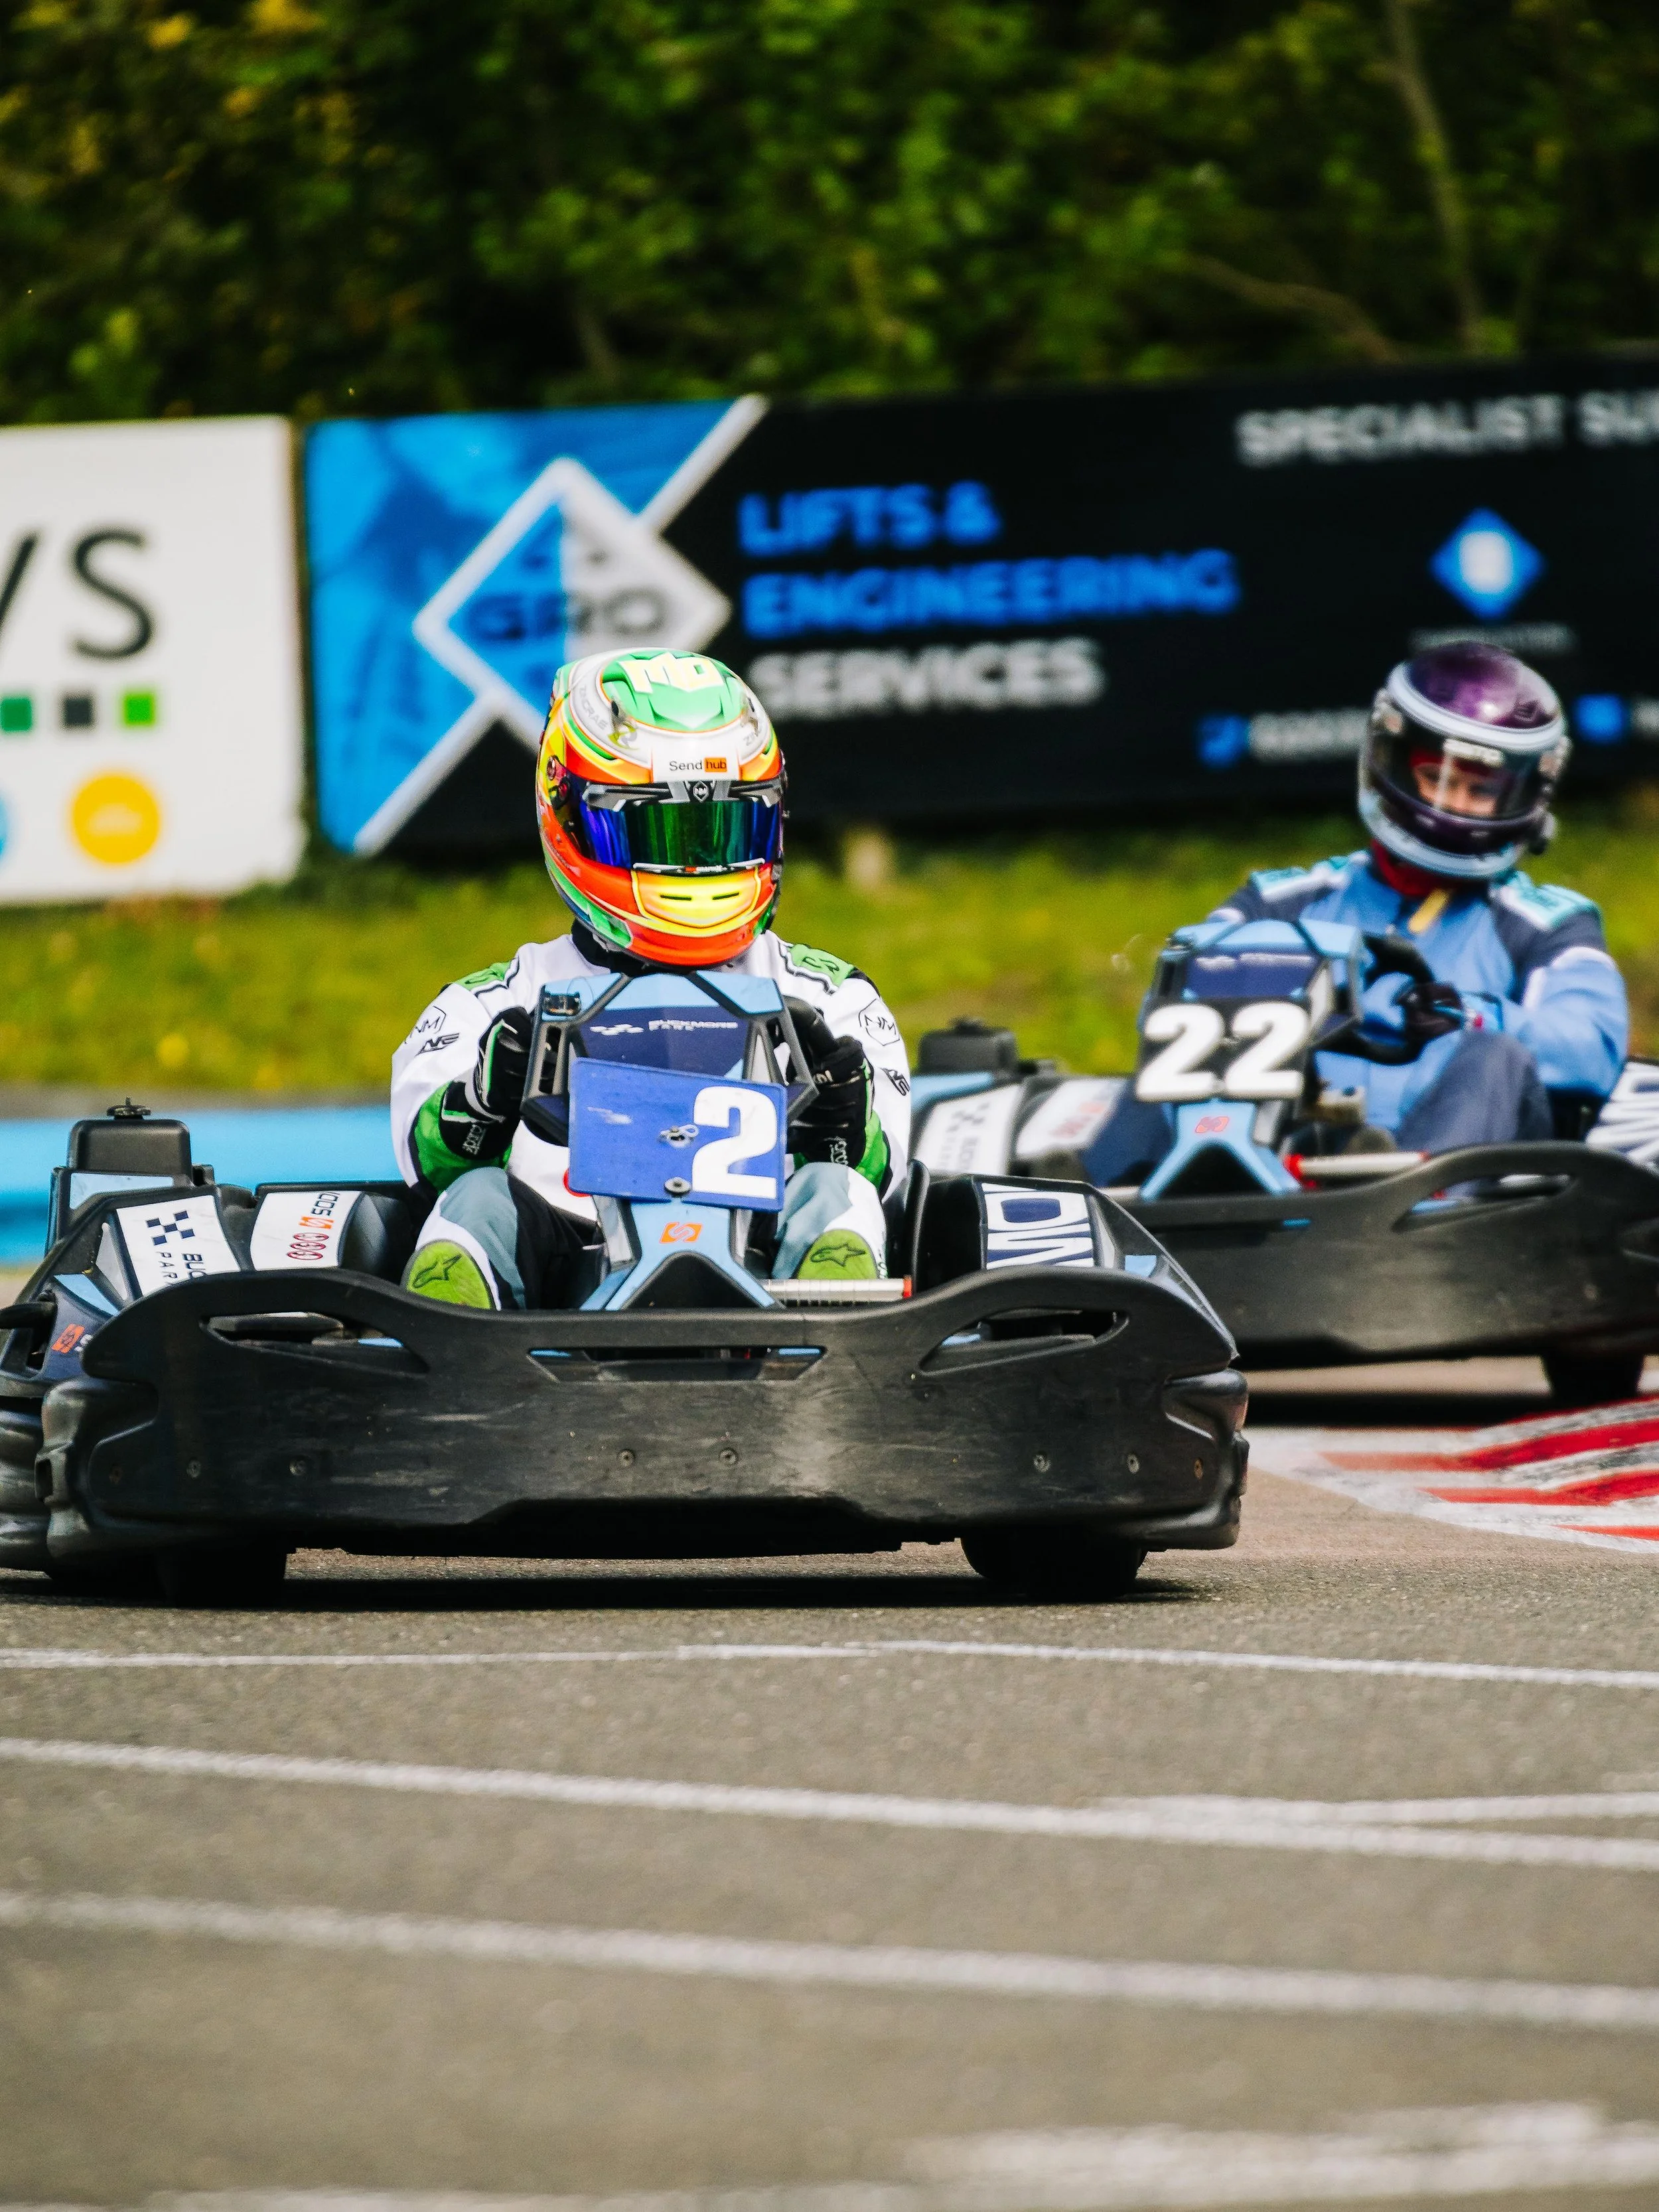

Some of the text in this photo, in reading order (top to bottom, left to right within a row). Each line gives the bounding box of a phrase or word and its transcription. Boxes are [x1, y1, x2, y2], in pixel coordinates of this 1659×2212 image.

[1238, 398, 1561, 463] SPECIALIST
[741, 480, 999, 553] LIFTS &
[745, 550, 1236, 635] ENGINEERING
[753, 639, 1099, 717] SERVICES
[669, 758, 727, 771] Send hub
[1137, 1003, 1307, 1100] 22
[691, 1086, 778, 1199] 2
